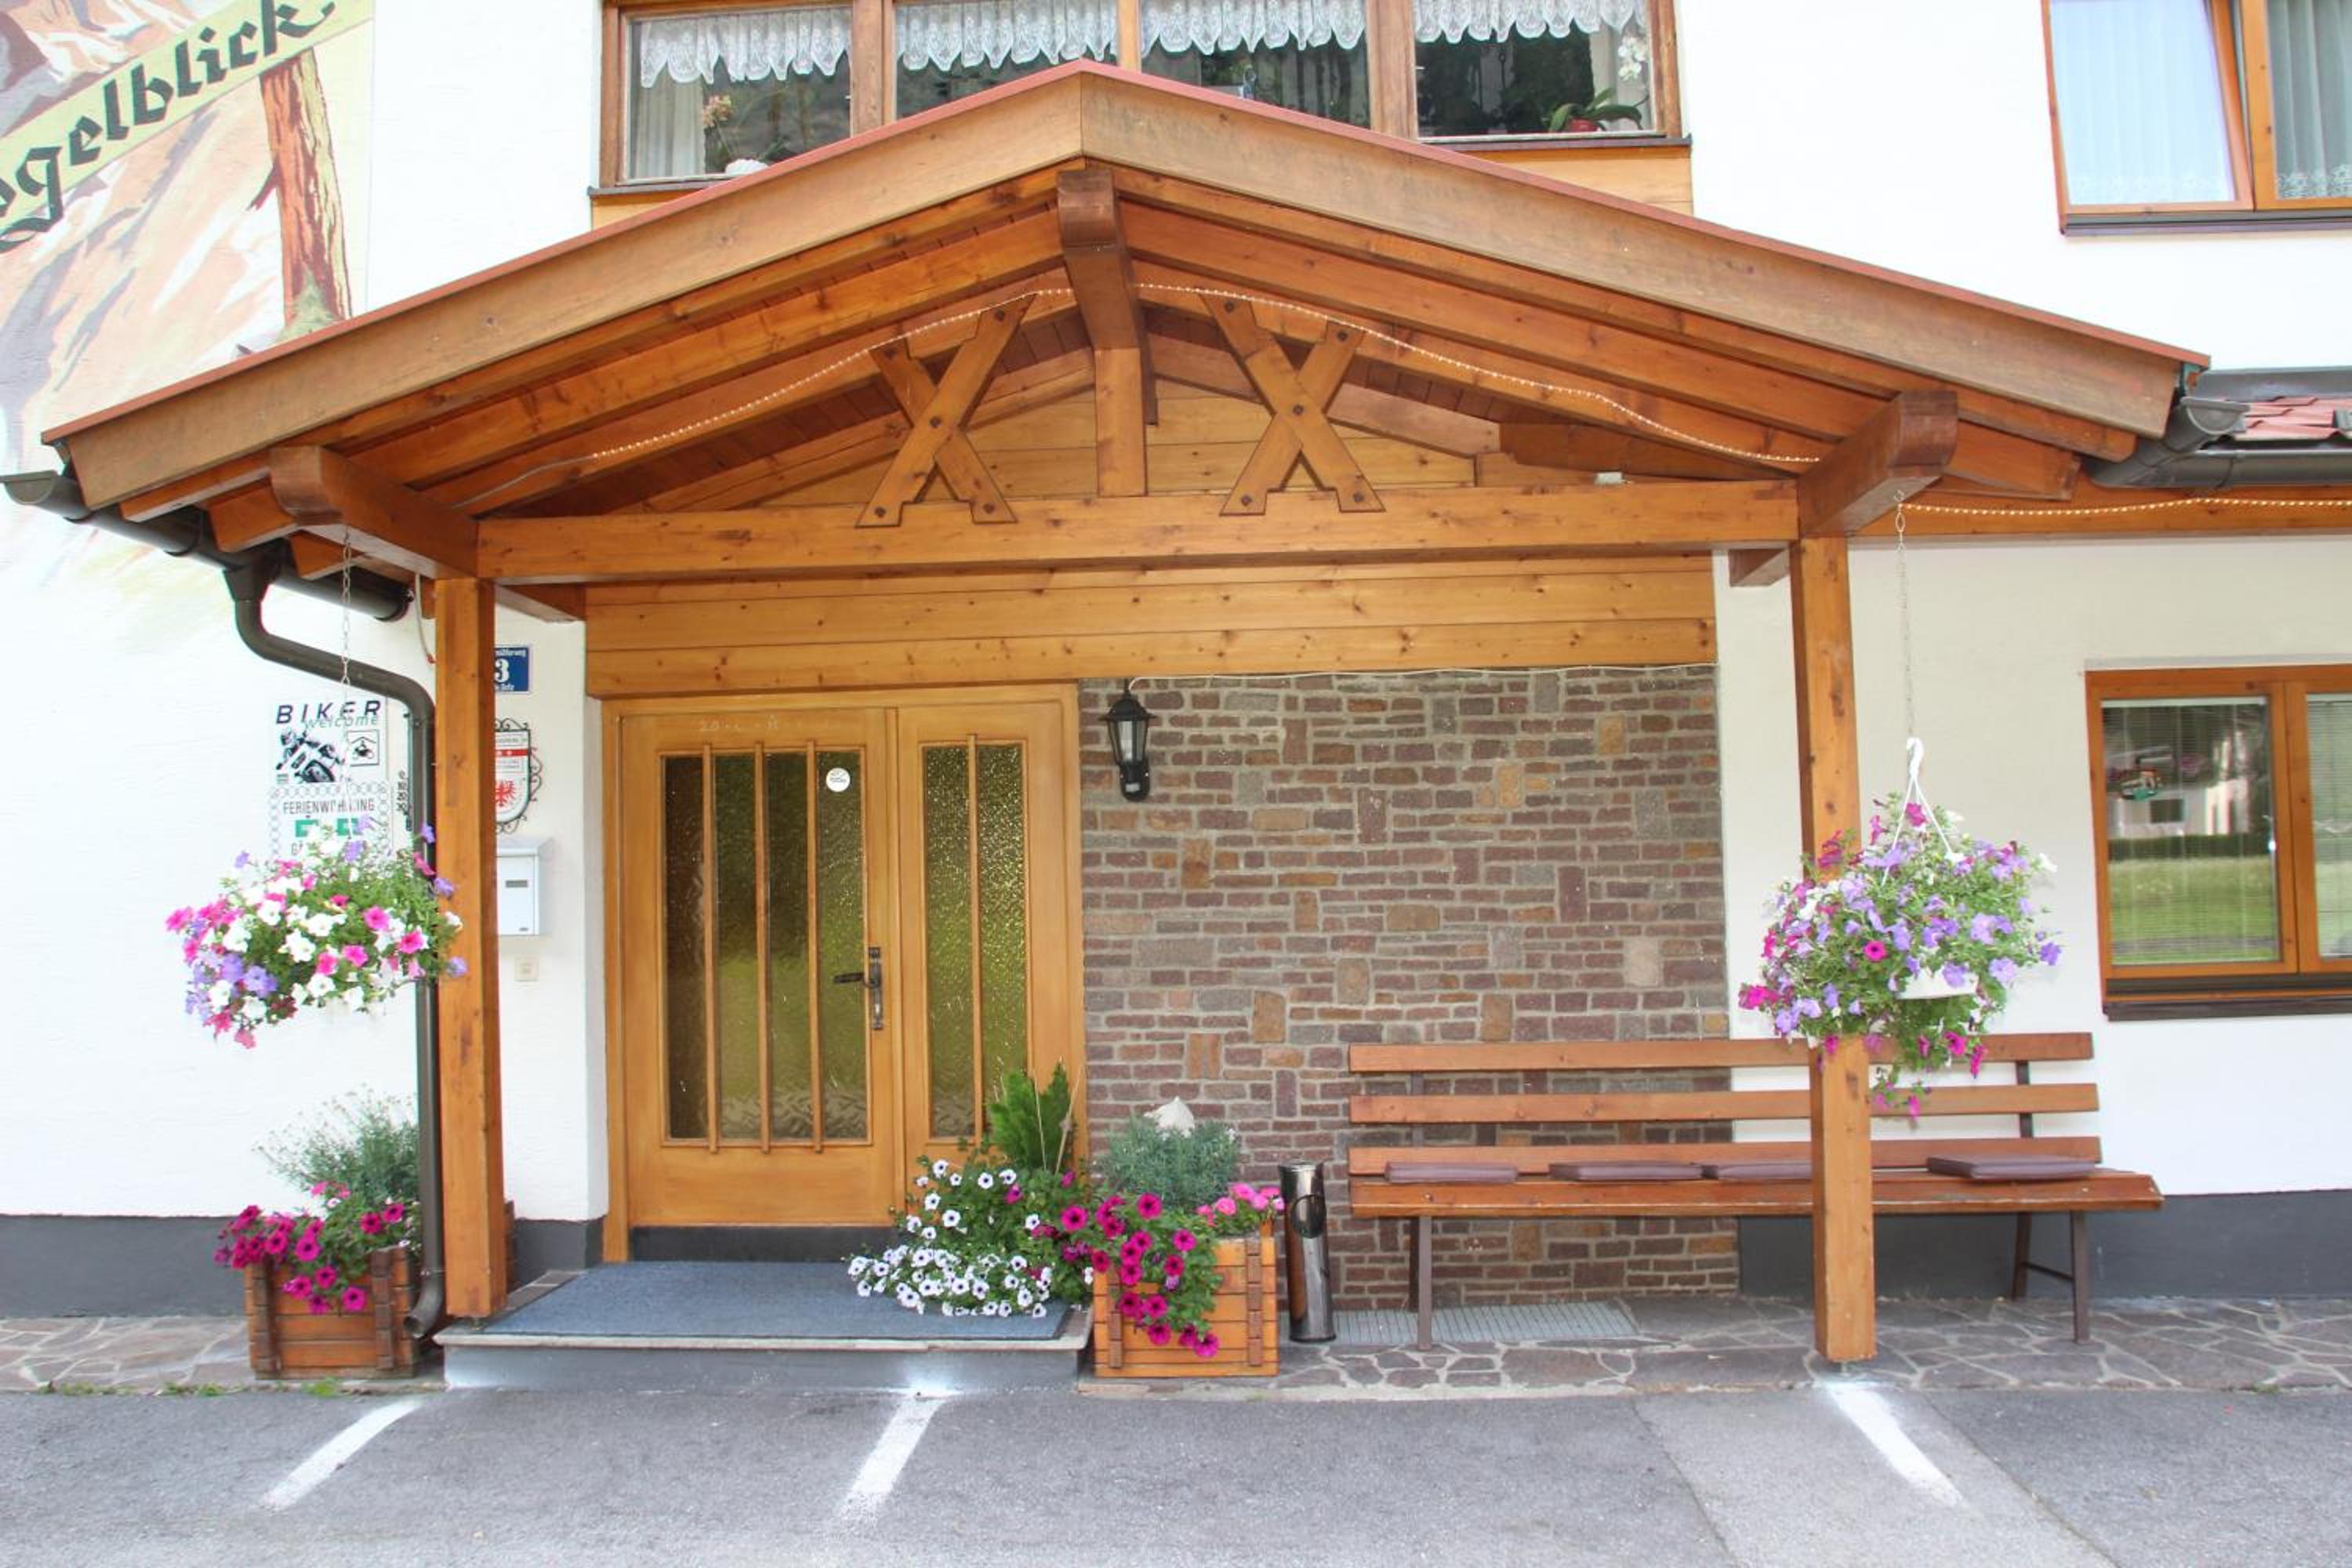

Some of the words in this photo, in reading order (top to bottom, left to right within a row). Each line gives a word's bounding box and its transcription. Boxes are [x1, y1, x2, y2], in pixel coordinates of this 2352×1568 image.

[494, 658, 510, 683] 3
[276, 700, 381, 724] BIKER
[283, 797, 375, 815] FERIENWHNG
